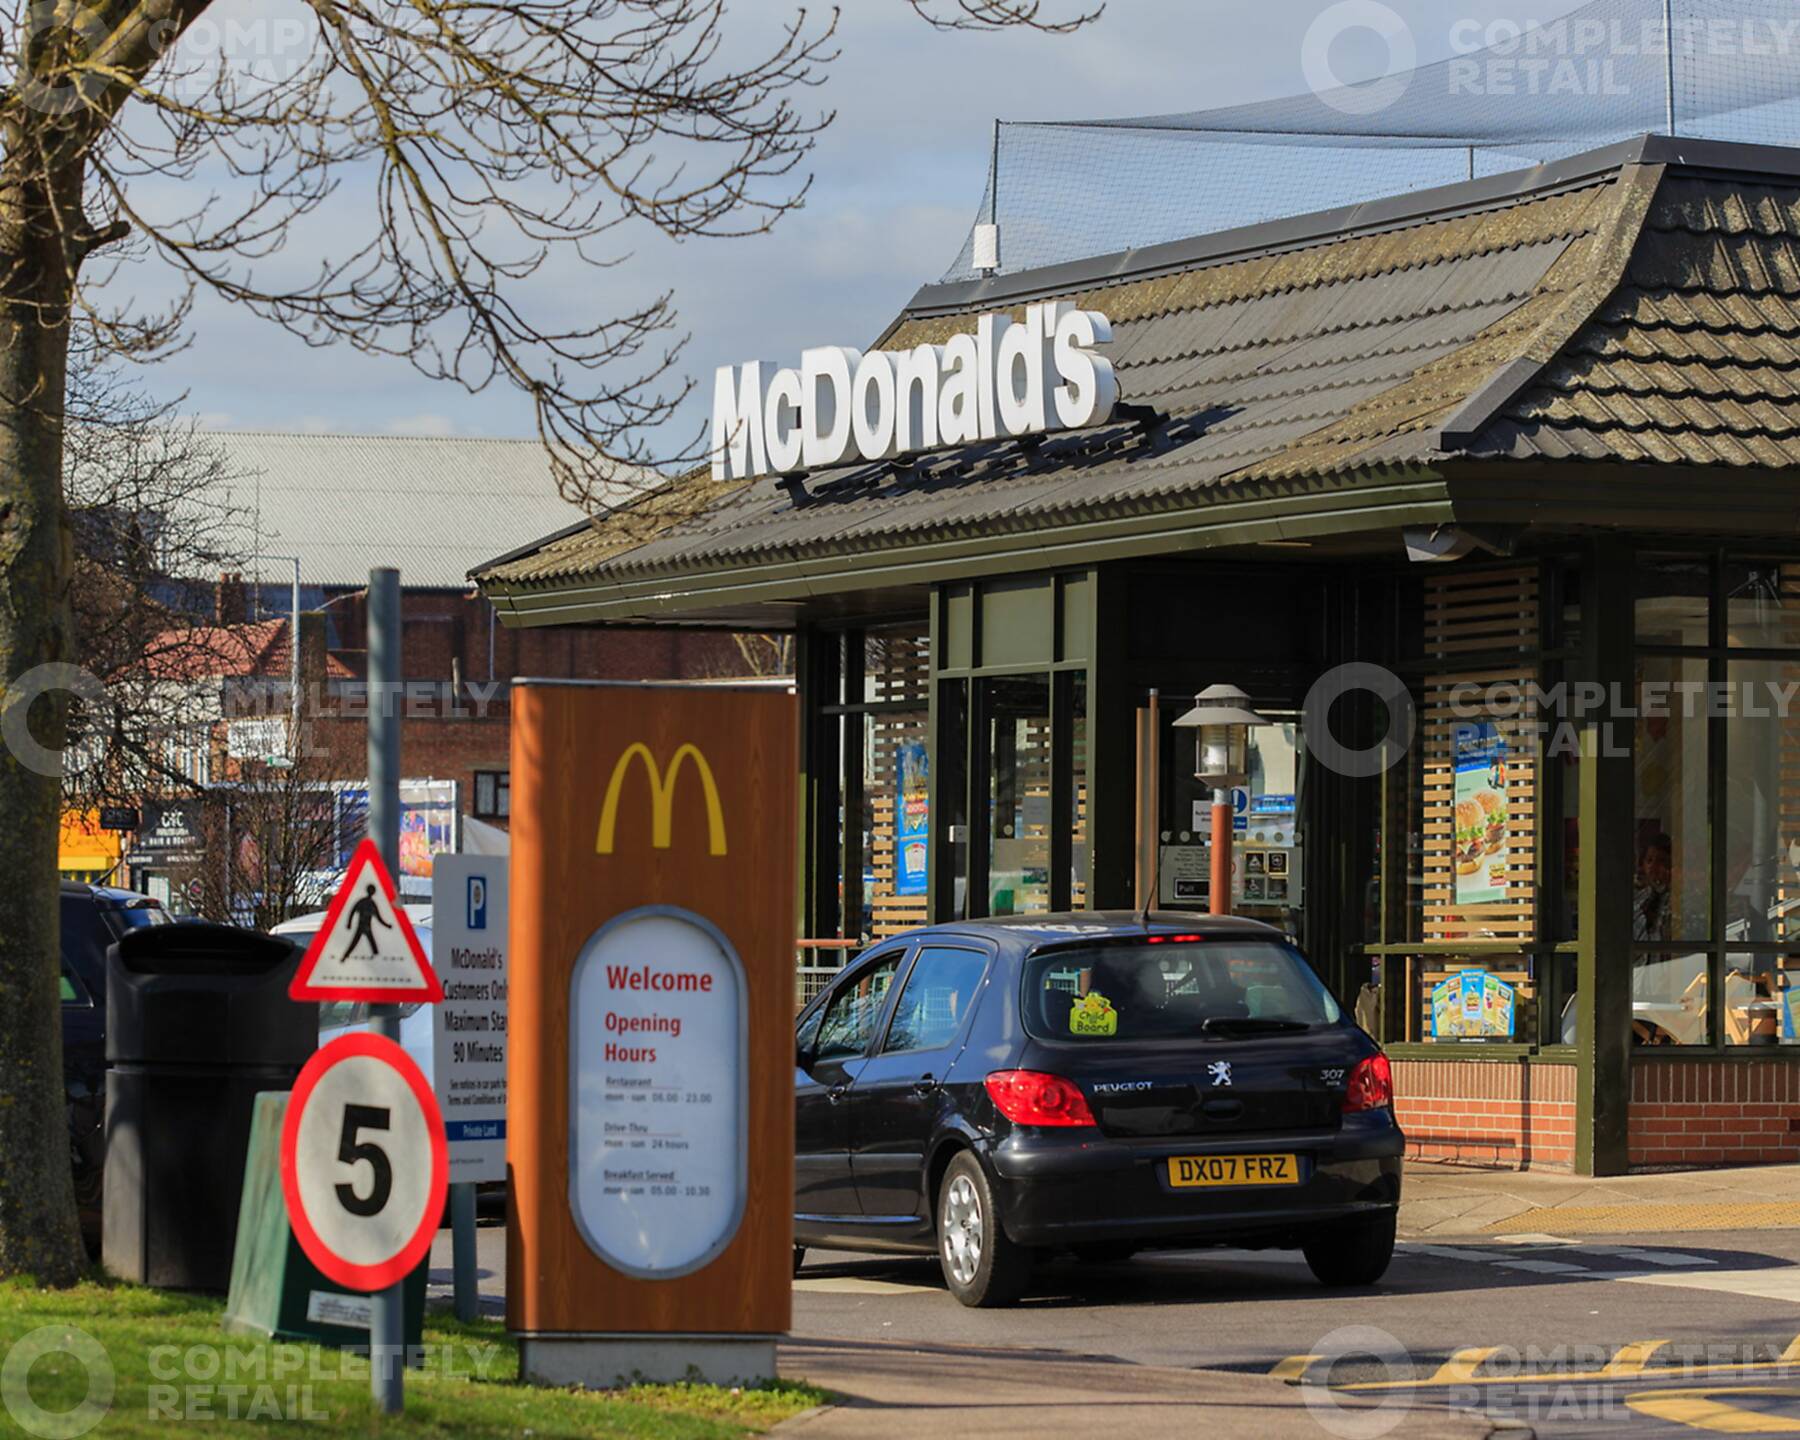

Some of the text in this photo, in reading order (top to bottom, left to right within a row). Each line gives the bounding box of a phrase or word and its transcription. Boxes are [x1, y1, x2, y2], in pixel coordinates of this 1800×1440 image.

[712, 301, 1114, 481] McDonald's
[451, 948, 503, 969] McDonald's
[443, 978, 508, 1000] Customers Onl
[606, 965, 713, 992] Welcome
[445, 1008, 489, 1031] Maximum
[605, 1011, 681, 1037] Opening
[1079, 1010, 1105, 1021] Child
[1077, 1021, 1109, 1032] Board
[453, 1041, 503, 1063] 90 Minutes
[605, 1042, 656, 1062] Hours
[605, 1076, 653, 1087] Restaurant
[1320, 1069, 1345, 1080] 307
[1094, 1081, 1153, 1092] PEUGEOT
[335, 1104, 392, 1217] 5
[1178, 1157, 1288, 1181] DX07 FRZ
[604, 1169, 675, 1181] Breakfast Served
